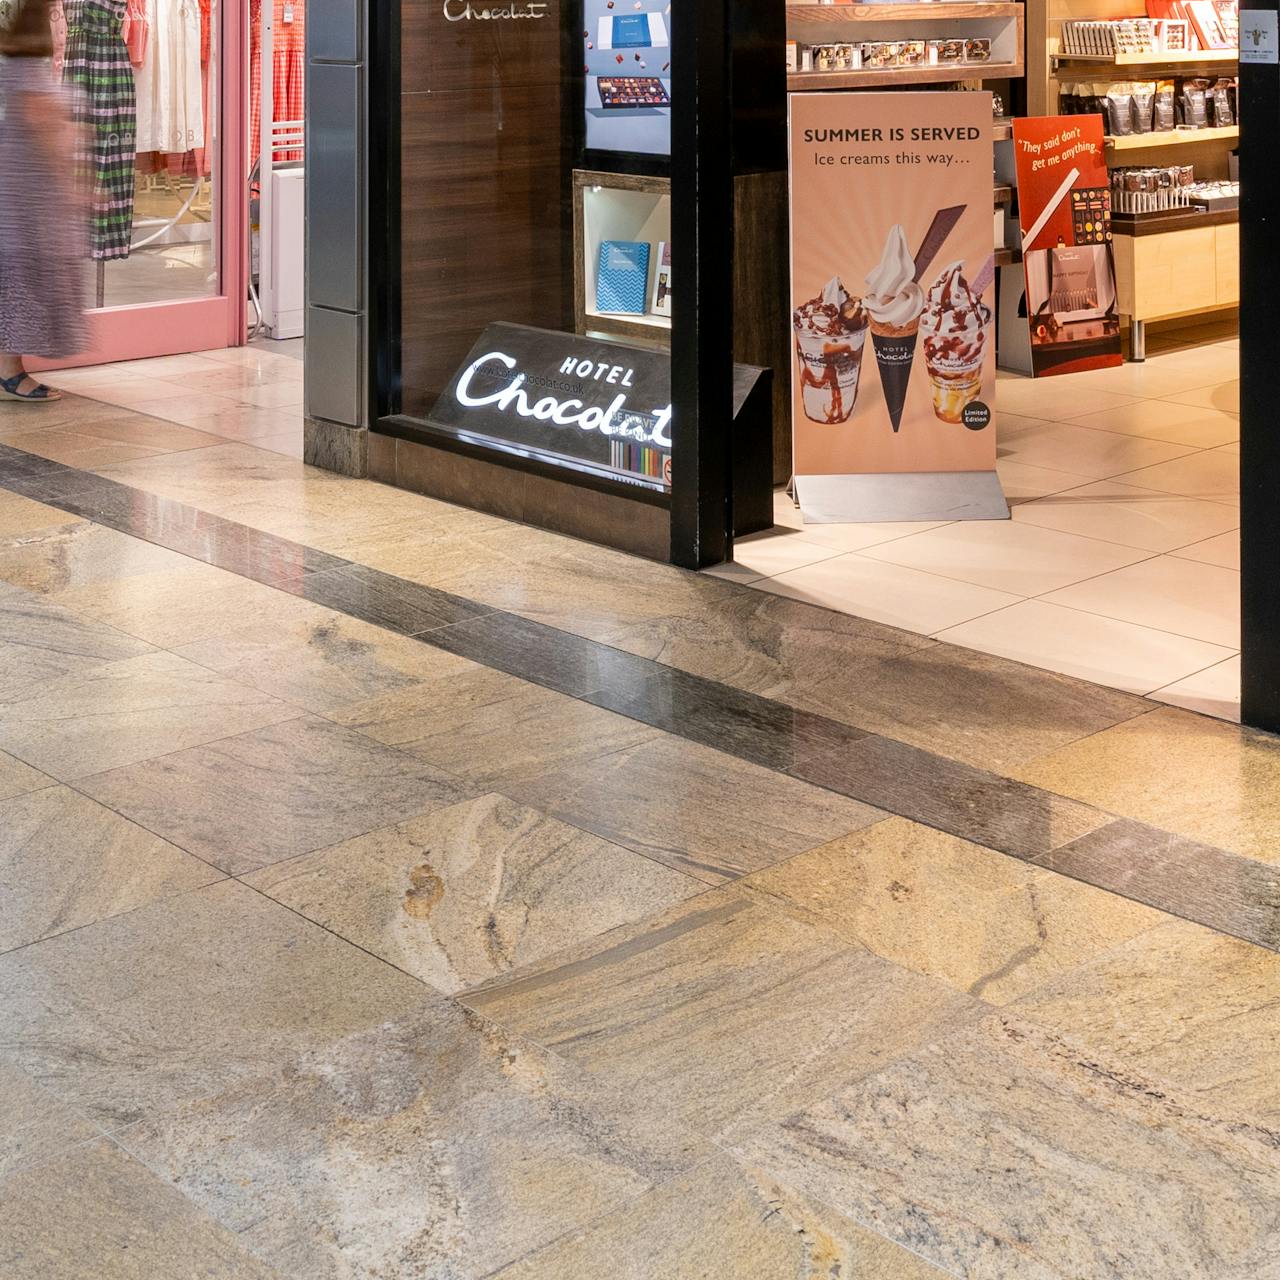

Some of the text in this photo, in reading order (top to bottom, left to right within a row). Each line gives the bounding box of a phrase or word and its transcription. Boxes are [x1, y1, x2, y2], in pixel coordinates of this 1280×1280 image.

[804, 127, 980, 142] SUMMER IS SERVED
[1043, 134, 1060, 150] said
[815, 153, 834, 165] Ice
[840, 154, 890, 165] creams
[896, 152, 921, 164] this
[1032, 159, 1046, 171] get
[1048, 155, 1060, 166] me
[560, 356, 634, 387] HOTEL
